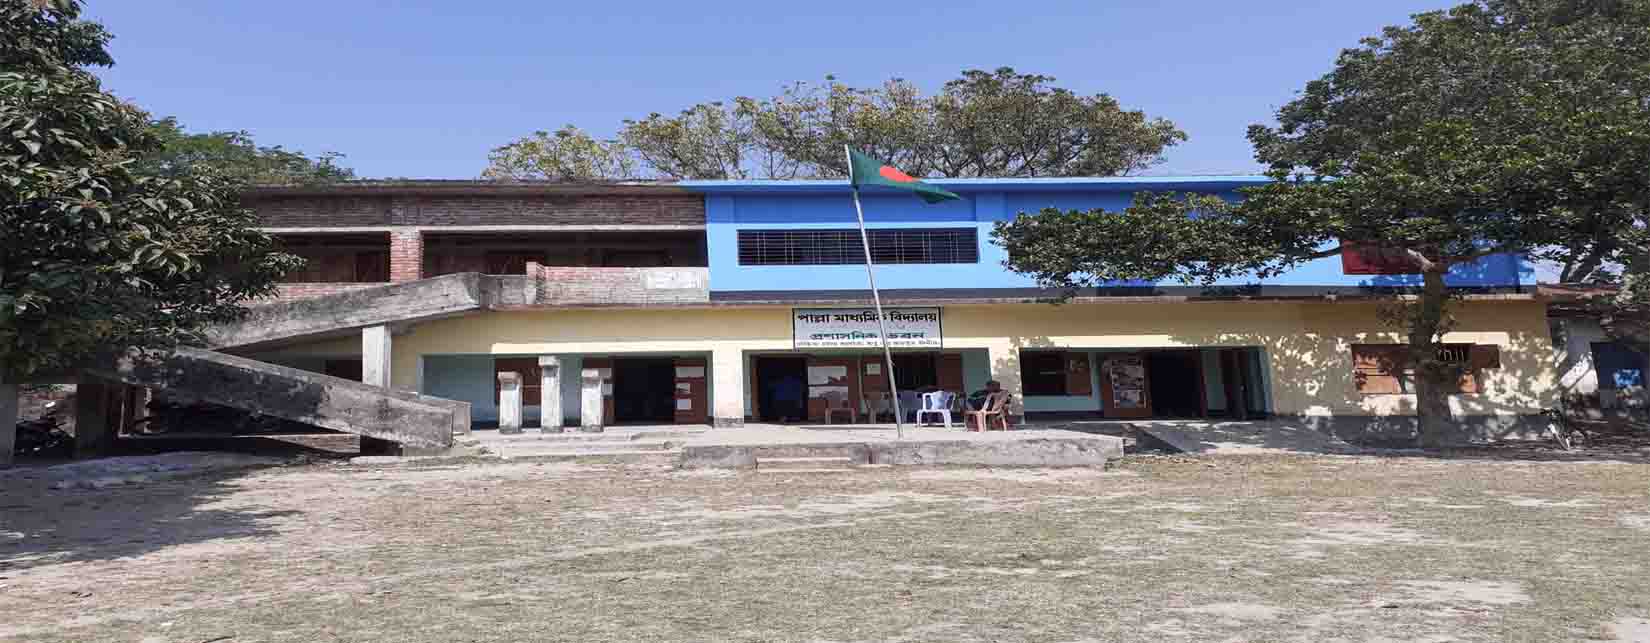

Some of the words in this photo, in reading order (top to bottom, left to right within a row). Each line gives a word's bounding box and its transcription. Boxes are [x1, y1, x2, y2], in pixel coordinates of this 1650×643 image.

[833, 311, 887, 322] মাধ্যমিক
[890, 311, 937, 322] বিদ্যালয়
[809, 330, 878, 340] প্রশাসনিক
